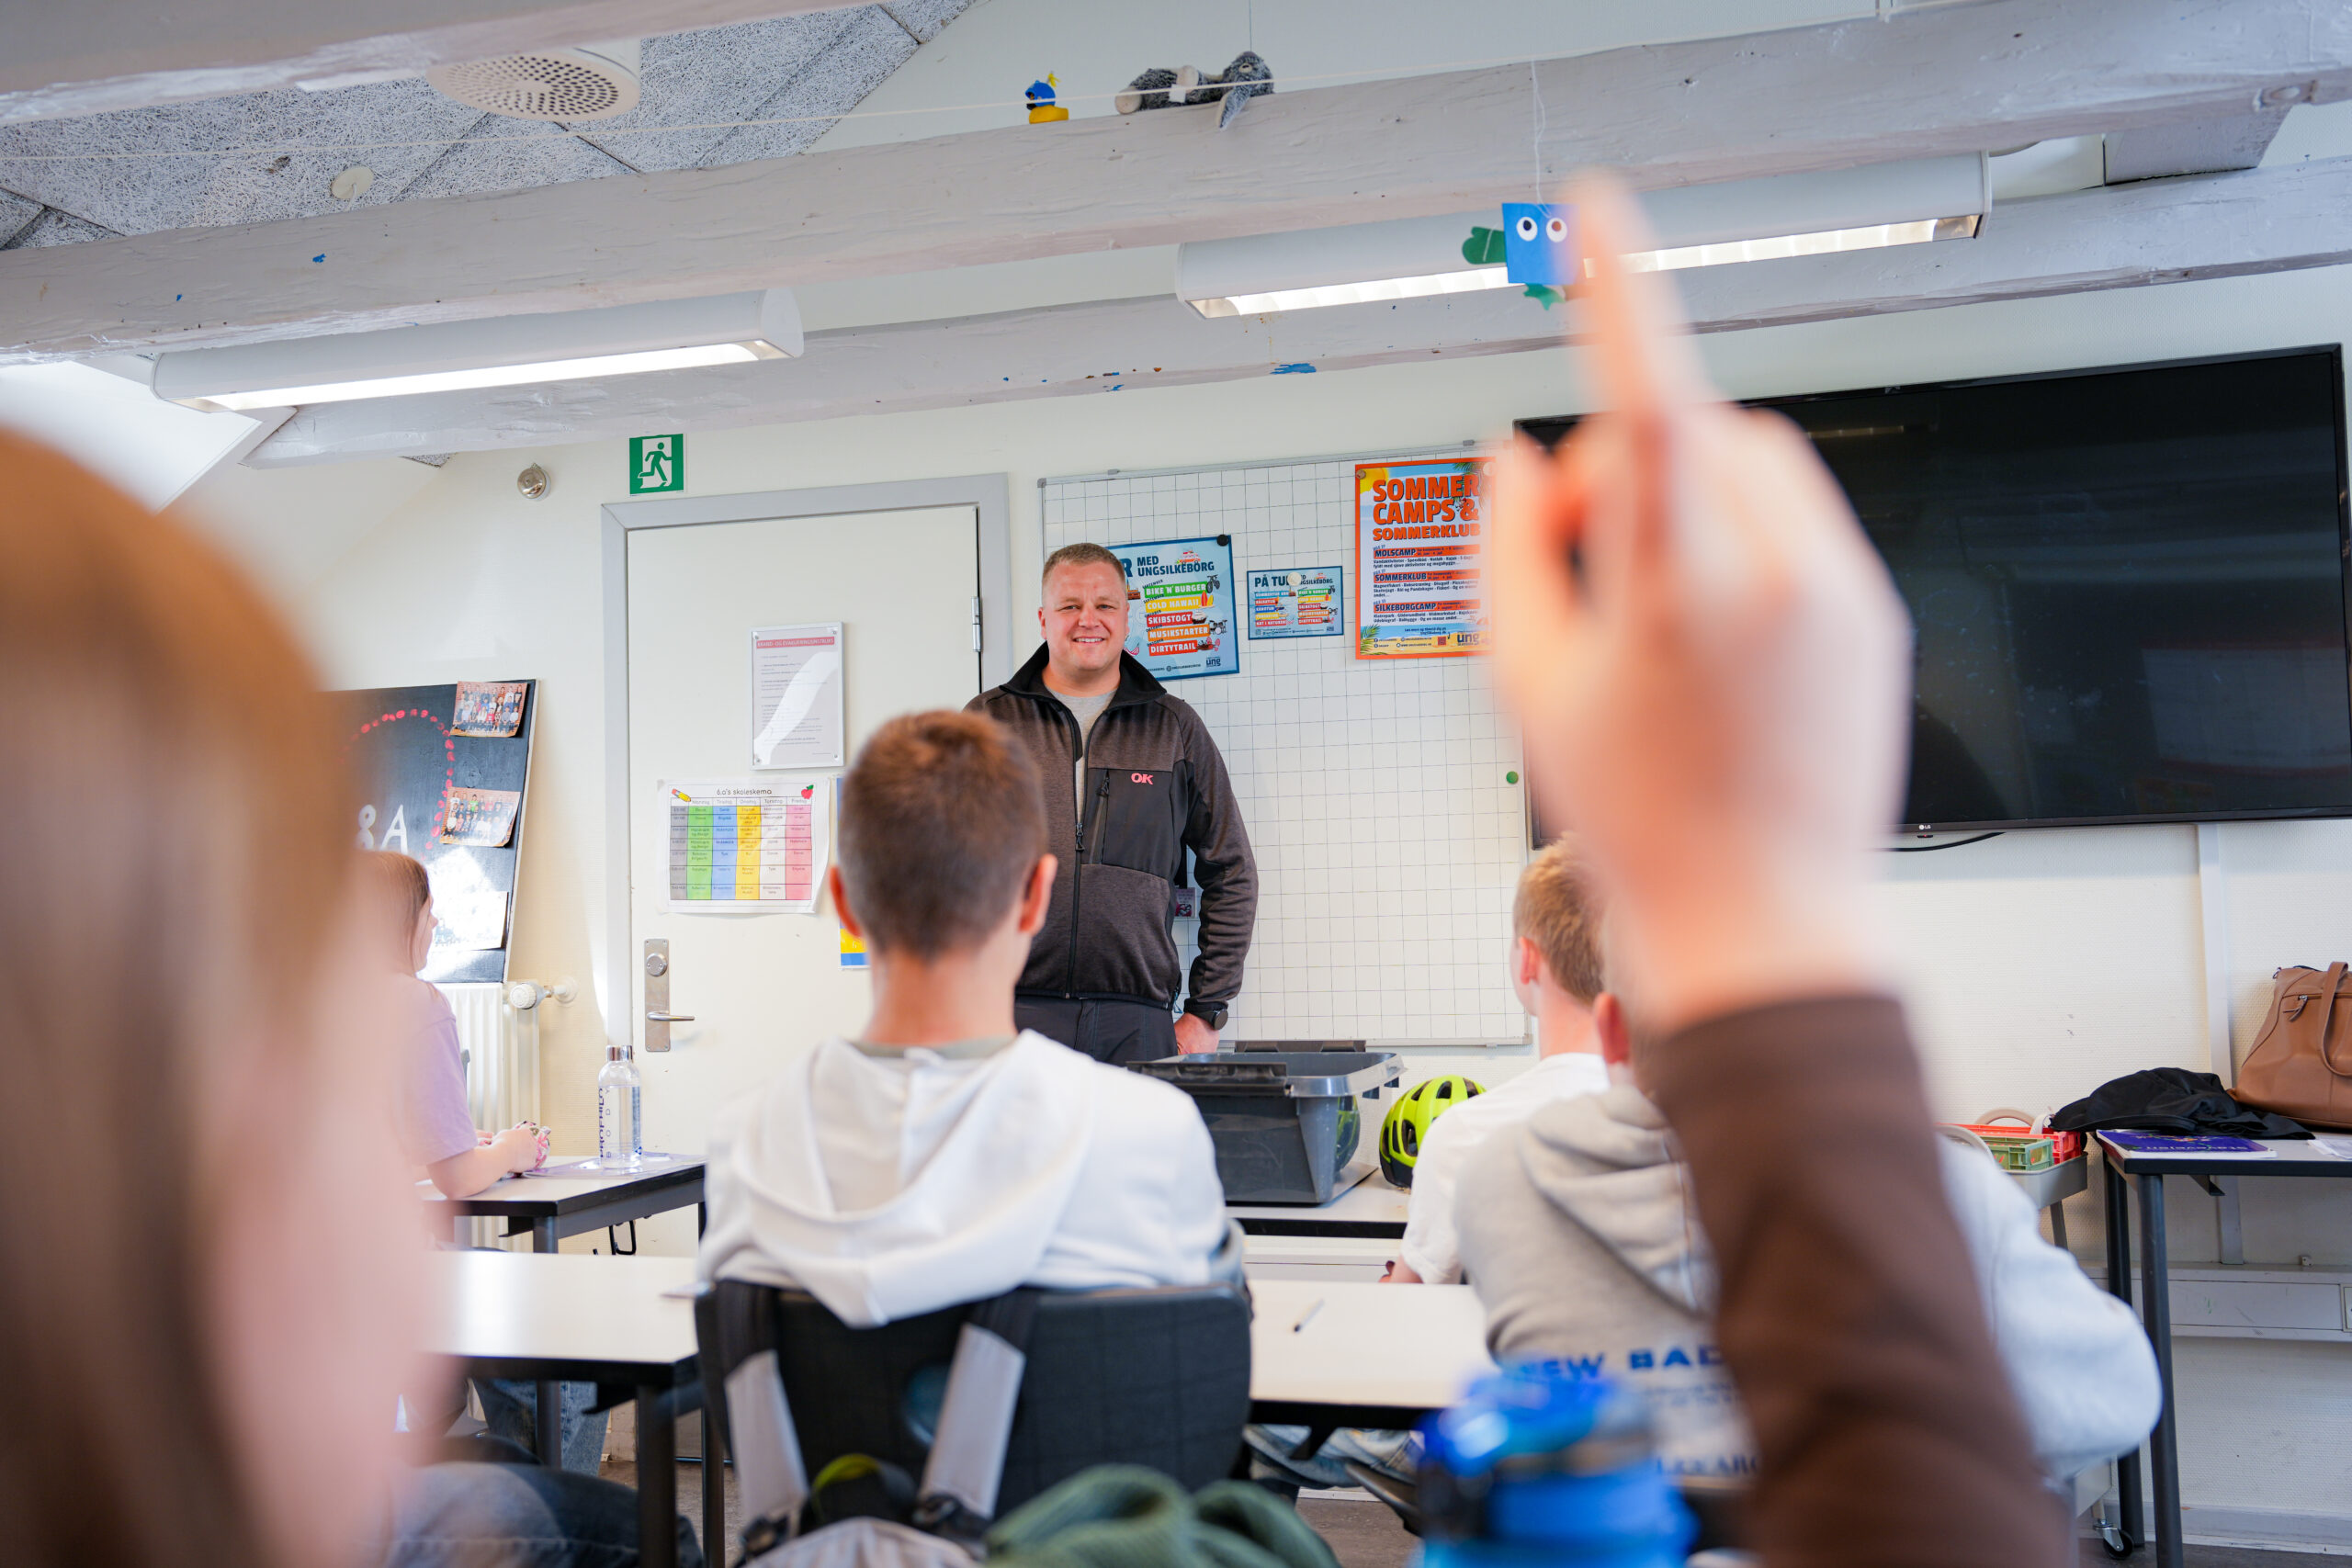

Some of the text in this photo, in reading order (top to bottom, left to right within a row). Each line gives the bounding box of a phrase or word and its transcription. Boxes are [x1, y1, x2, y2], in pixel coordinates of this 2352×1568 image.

[1373, 474, 1479, 502] SOMMER
[1374, 499, 1479, 525] CAMPS &
[1373, 524, 1480, 541] SOMMERKLUB
[1374, 548, 1417, 558] MOLSCAMP
[1136, 556, 1159, 567] MED
[1137, 561, 1215, 577] UNGSILKEBORG
[1254, 574, 1269, 587] PÅ
[1374, 572, 1427, 581] SOMMERKLUB
[1146, 587, 1164, 595] BIKE
[1175, 583, 1206, 593] BURGER
[1147, 599, 1199, 610] COLD HAWAII
[1374, 603, 1437, 612] SILKEBORGCAMP
[1148, 615, 1192, 625] SKIBSTOGT
[1149, 626, 1209, 638] MUSIKSTARTER
[1150, 643, 1196, 653] DIRTYTRAIL
[1131, 773, 1154, 785] OK
